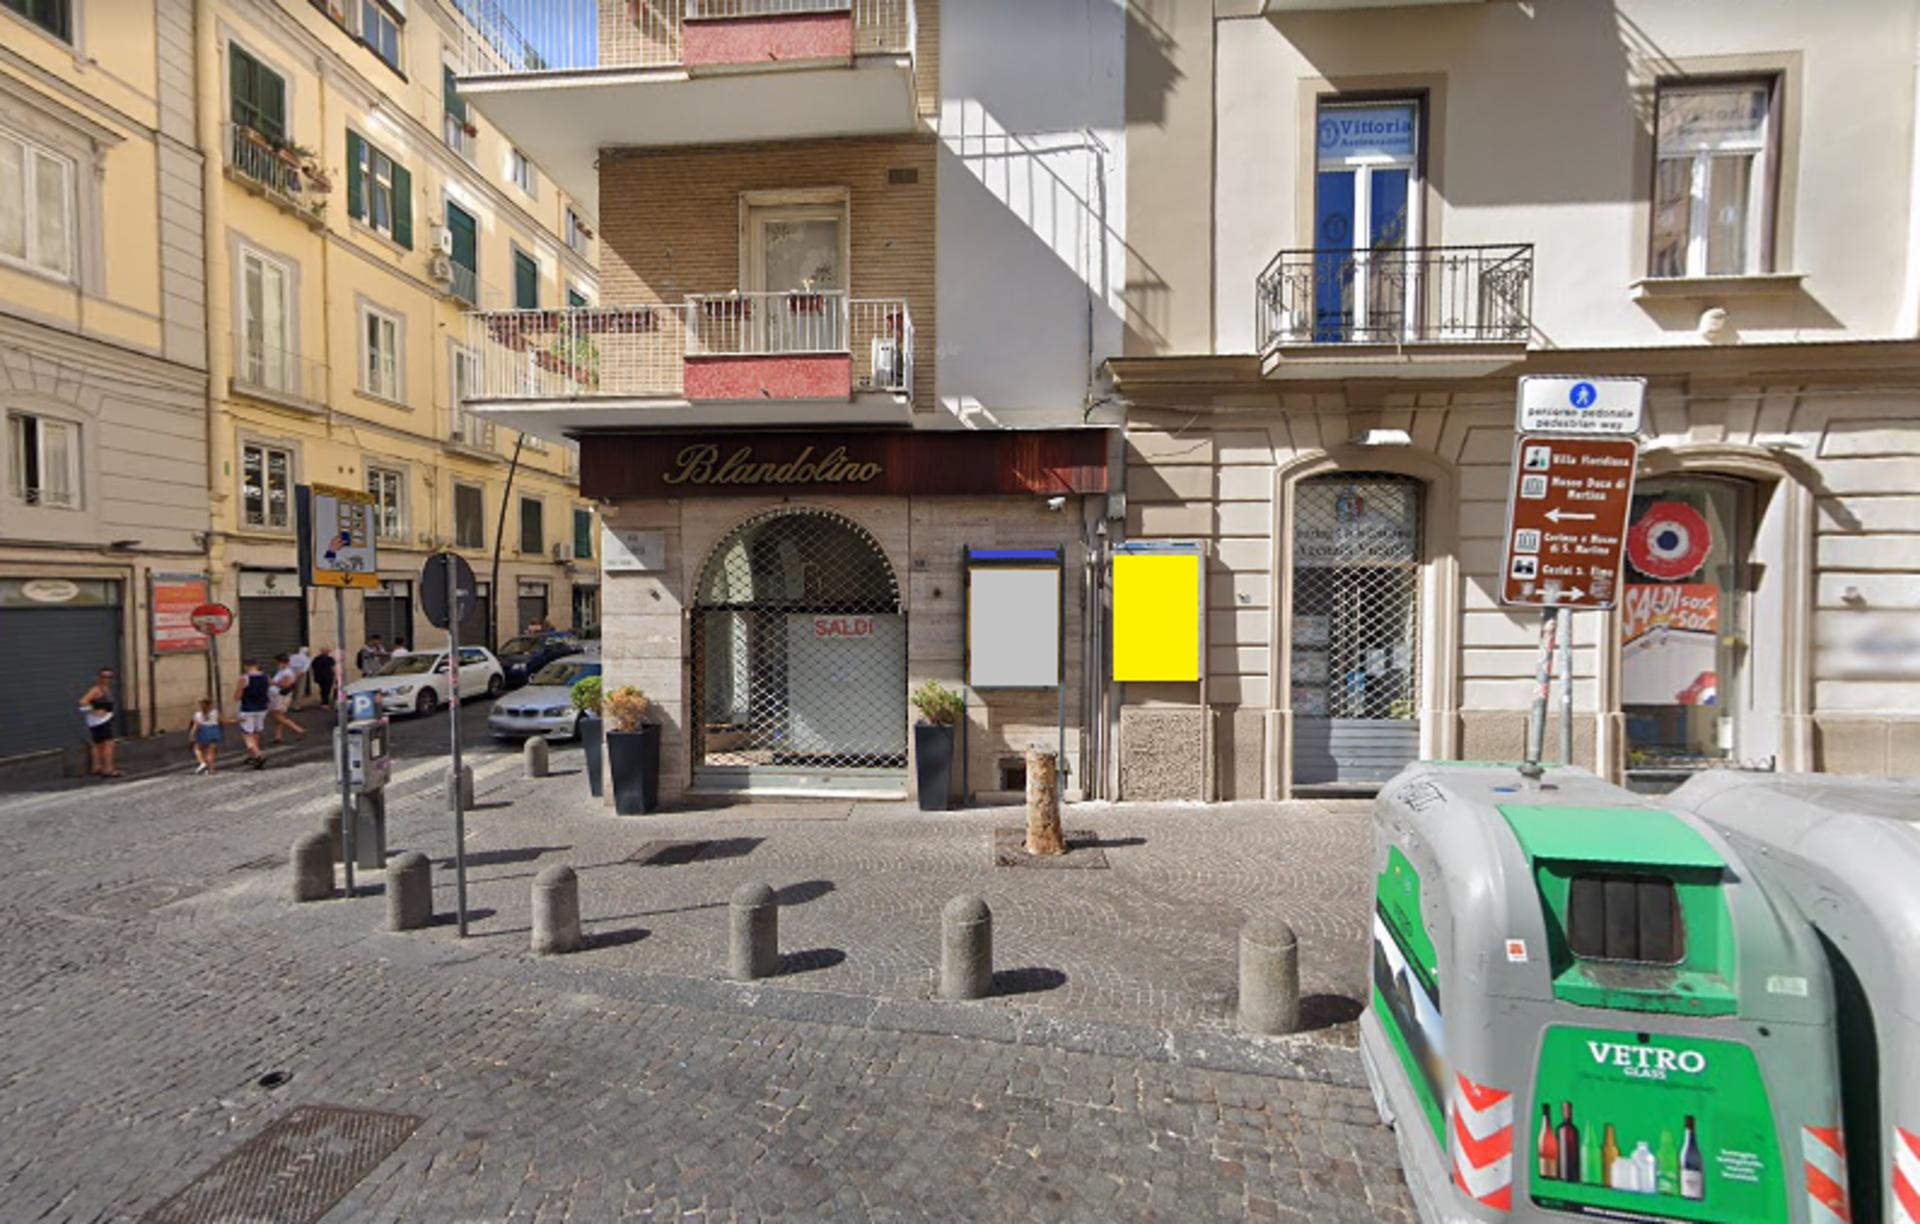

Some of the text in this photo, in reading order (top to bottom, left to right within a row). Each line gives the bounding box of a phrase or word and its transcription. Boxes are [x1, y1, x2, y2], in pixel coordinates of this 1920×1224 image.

[1341, 119, 1411, 134] Vittoria
[1581, 408, 1634, 418] pedonale
[1535, 418, 1624, 430] pedestrian way
[663, 443, 882, 484] Blandolino
[1552, 454, 1577, 465] Villa
[1615, 478, 1626, 489] di
[1620, 585, 1682, 635] SALDI
[814, 618, 873, 638] SALDI
[354, 695, 371, 714] P
[1586, 1040, 1706, 1073] VETRO
[1622, 1066, 1667, 1080] GLASS
